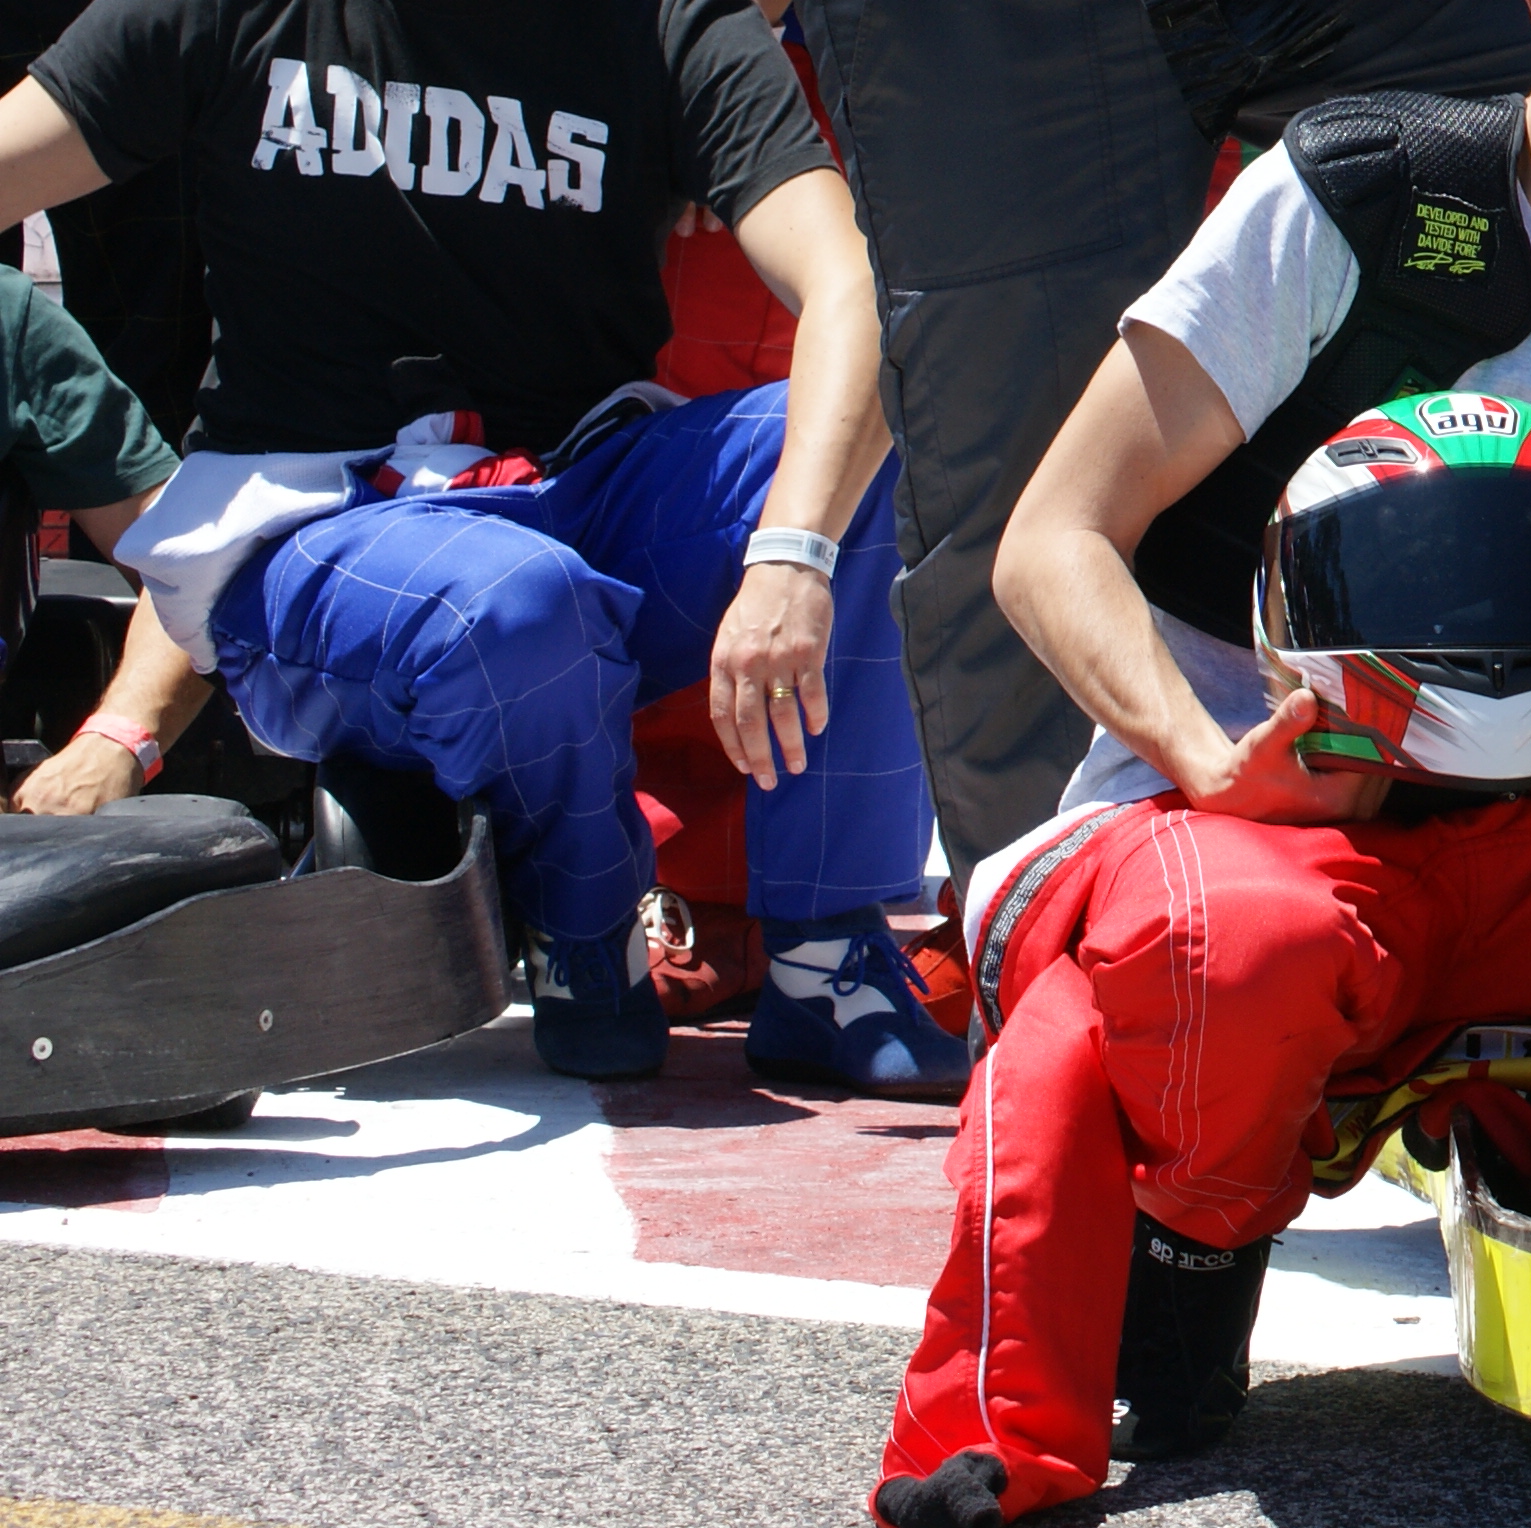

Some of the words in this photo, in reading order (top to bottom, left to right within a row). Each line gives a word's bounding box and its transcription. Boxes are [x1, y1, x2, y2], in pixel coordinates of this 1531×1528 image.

[252, 58, 609, 213] ADIDAS
[1416, 203, 1469, 227] DEVELOPED
[1470, 215, 1490, 232] AND
[1417, 233, 1455, 253] DAVIDE
[1424, 220, 1457, 239] TESTED
[1457, 227, 1481, 244] WITH
[1435, 408, 1509, 436] agv
